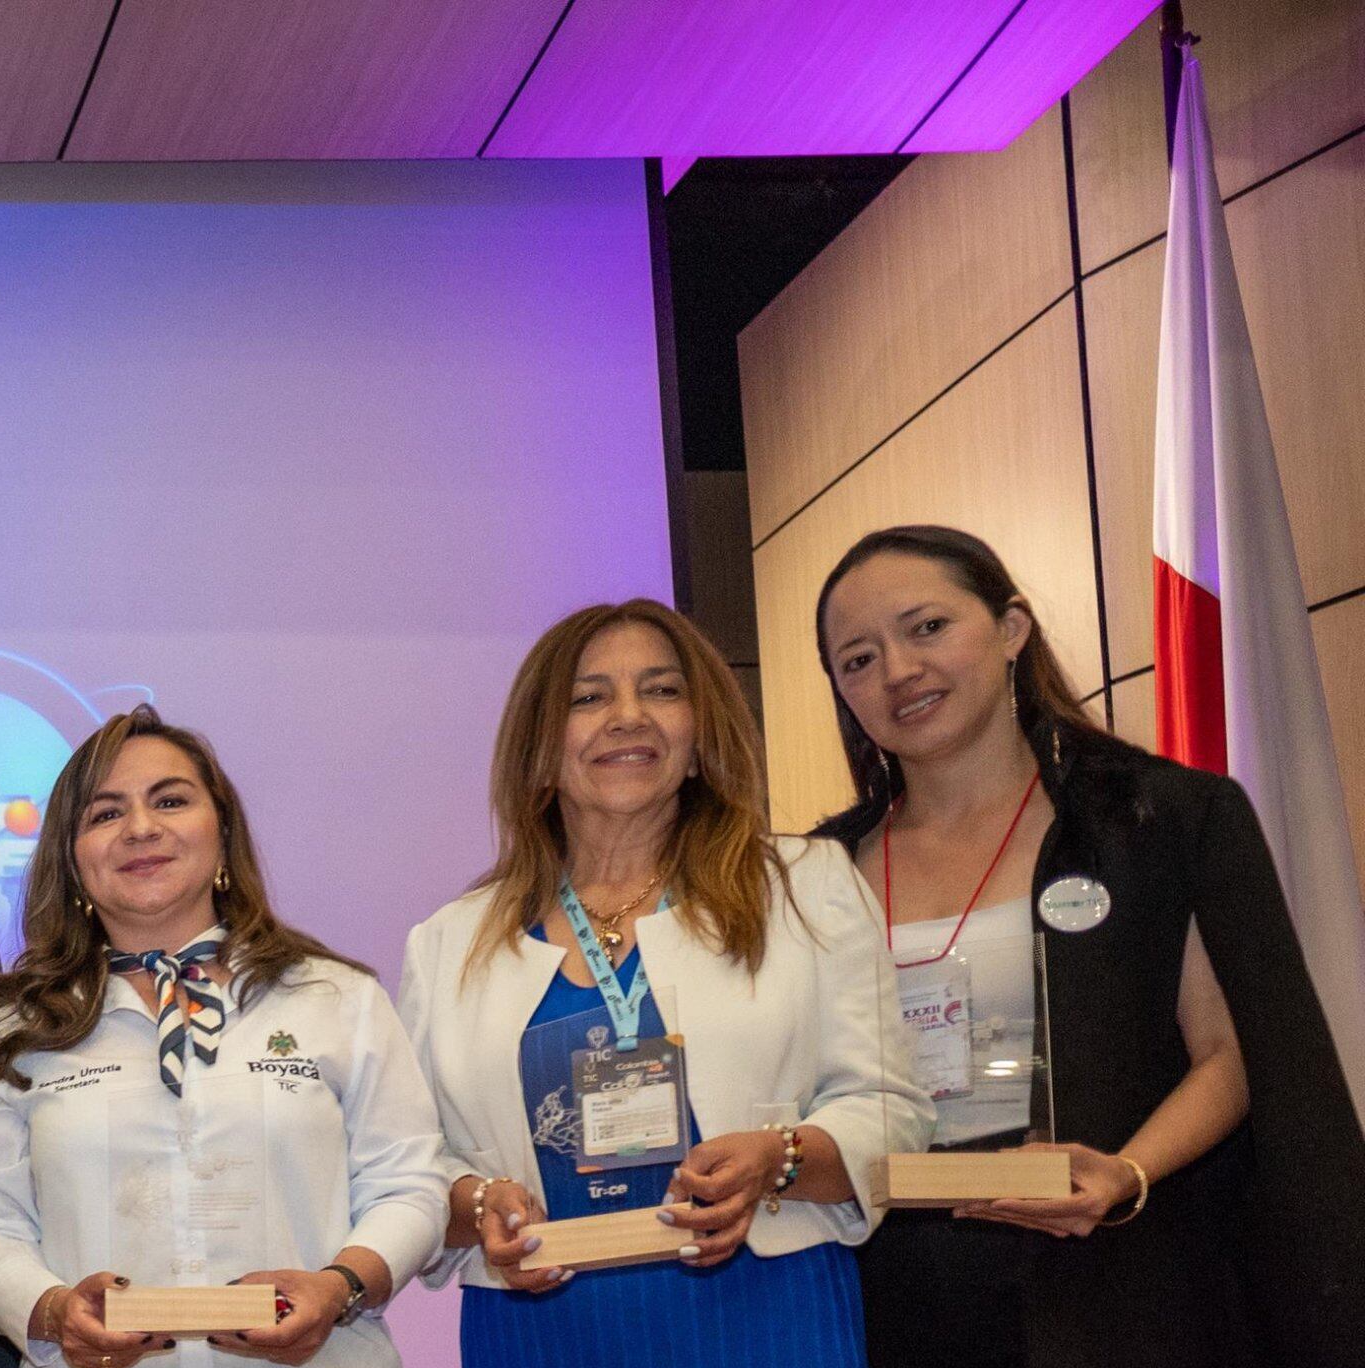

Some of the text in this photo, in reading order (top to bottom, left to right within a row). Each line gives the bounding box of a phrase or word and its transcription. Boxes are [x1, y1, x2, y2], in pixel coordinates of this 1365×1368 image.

[586, 1049, 612, 1063] TIC
[80, 1064, 121, 1077] Urrutia
[246, 1061, 320, 1080] Boyacá
[278, 1081, 298, 1094] TIC
